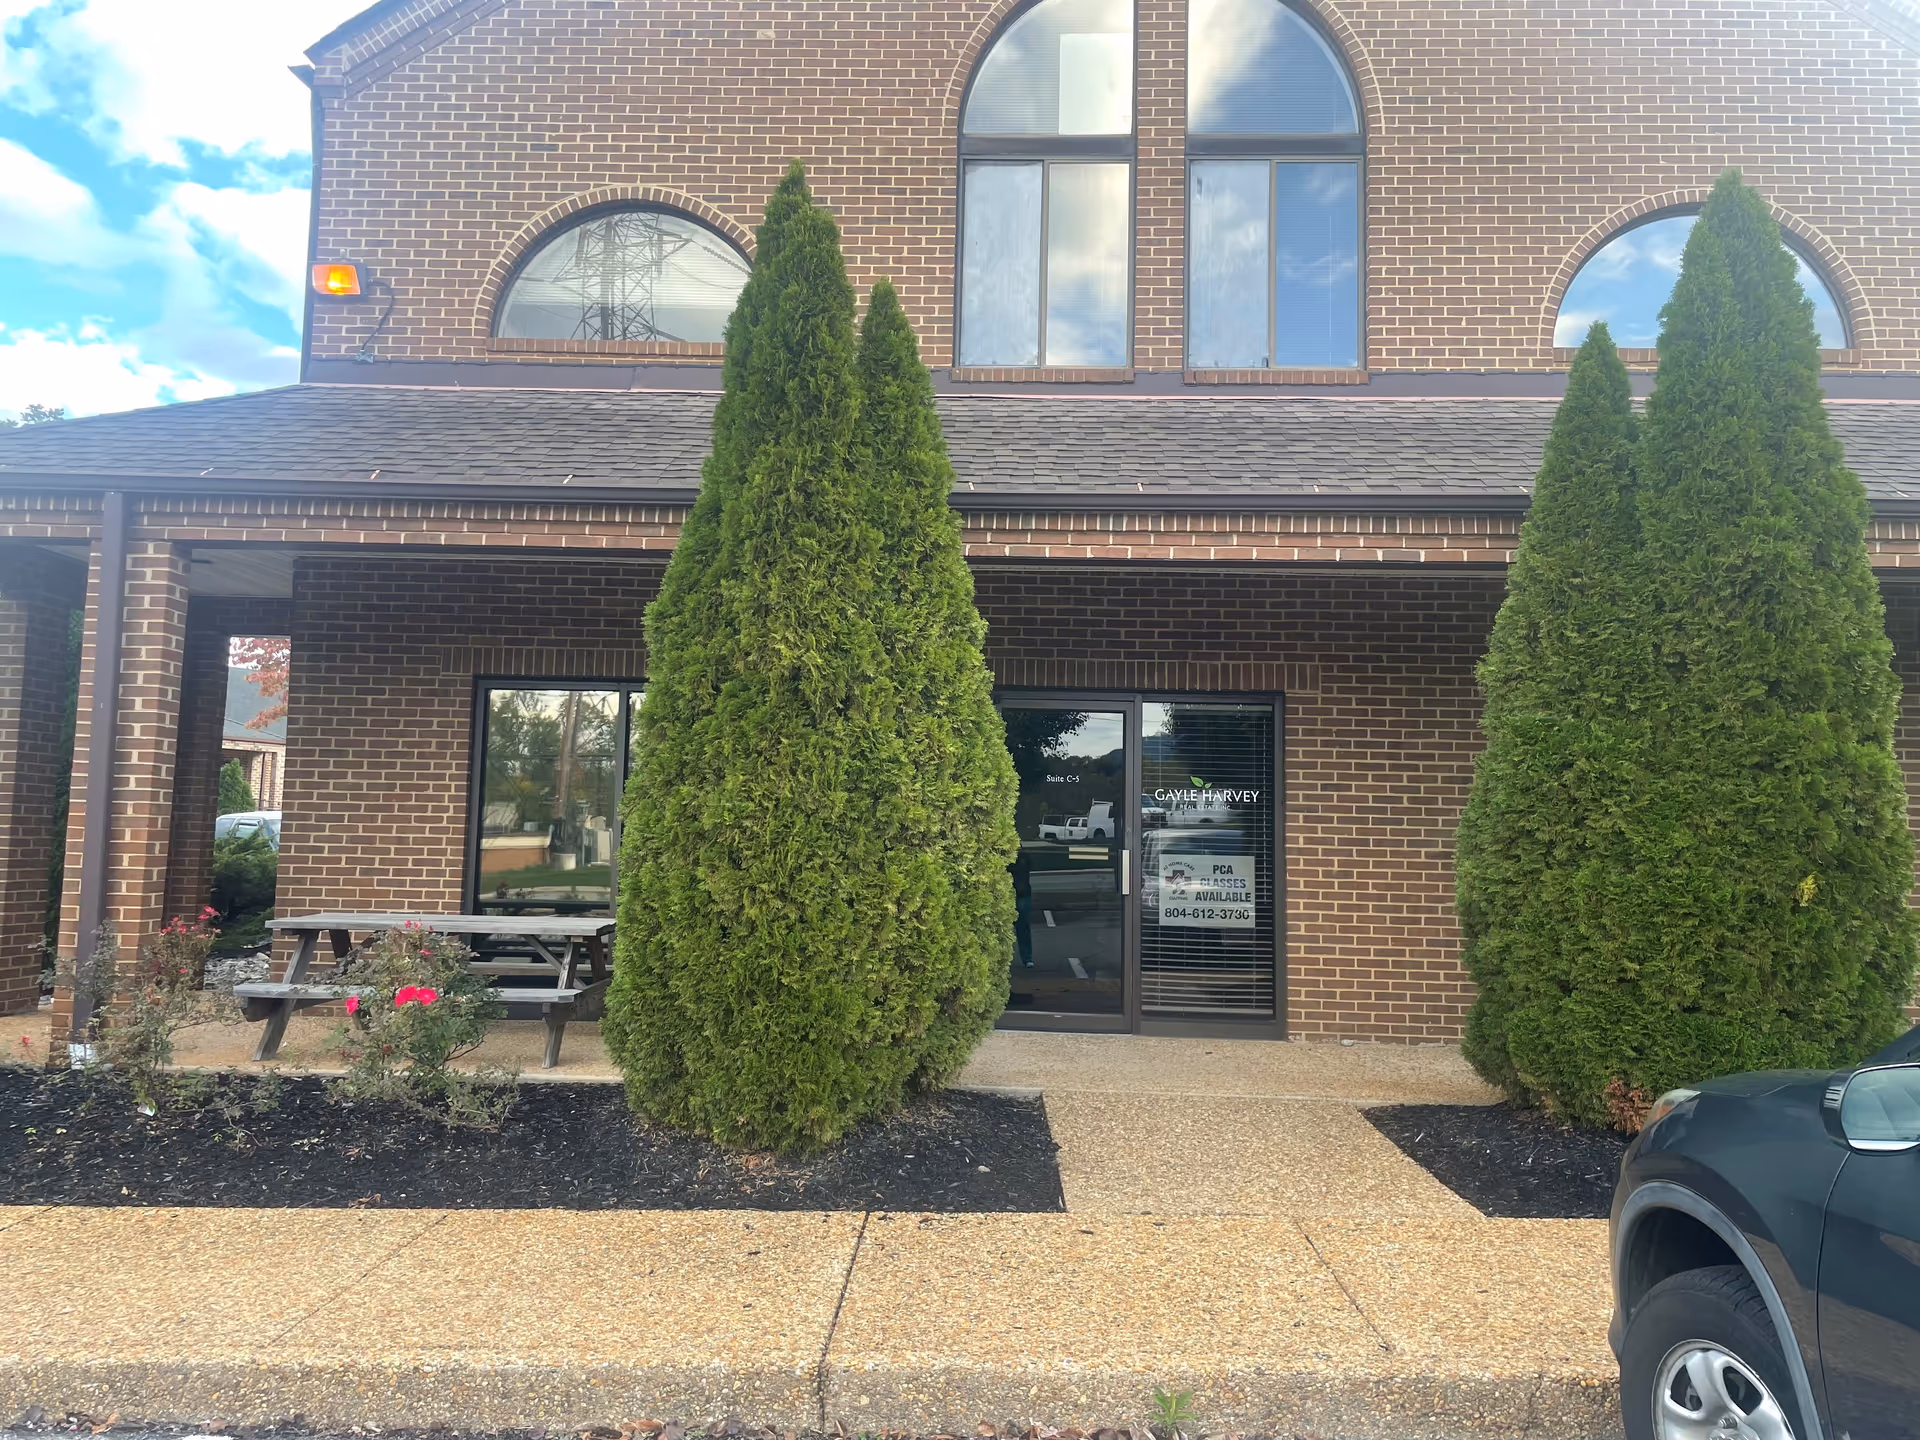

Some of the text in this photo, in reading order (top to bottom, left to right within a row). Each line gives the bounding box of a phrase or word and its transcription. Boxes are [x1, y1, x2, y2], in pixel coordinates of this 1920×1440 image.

[1046, 774, 1080, 783] Suite C-5
[1154, 788, 1260, 803] GAYLE HARVEY
[1184, 862, 1195, 871] CARE
[1213, 864, 1234, 875] PCA
[1200, 878, 1246, 888] CLASSES
[1195, 891, 1251, 902] AVAILABLE
[1164, 908, 1250, 919] 804-612-3730
